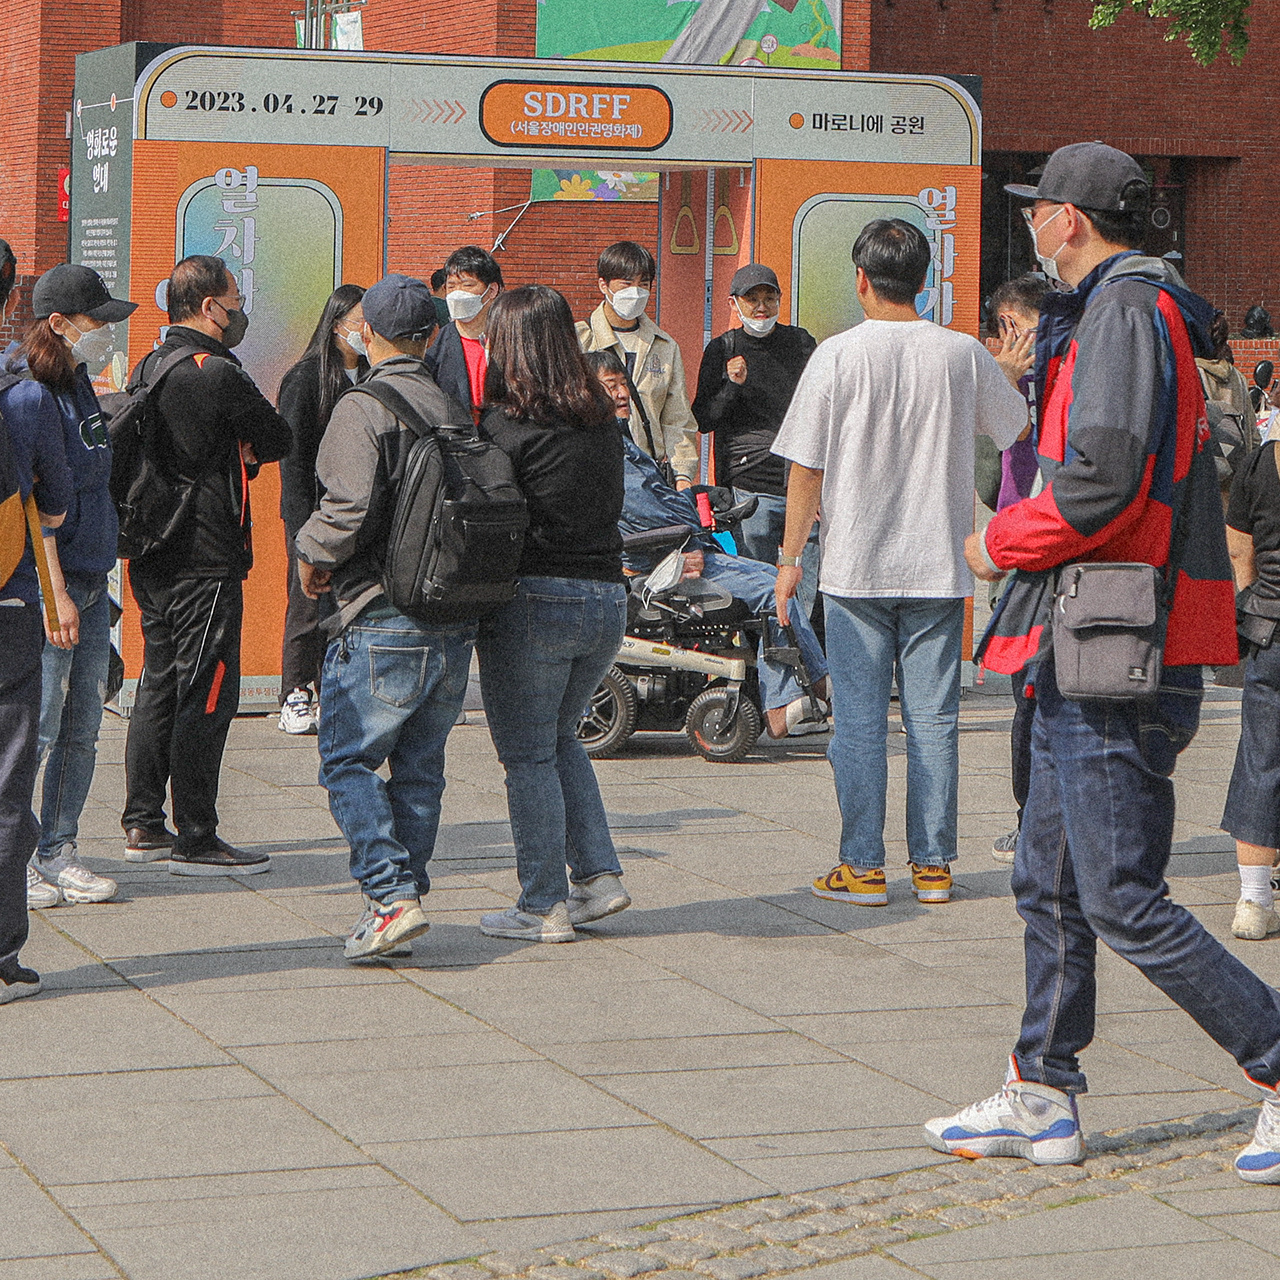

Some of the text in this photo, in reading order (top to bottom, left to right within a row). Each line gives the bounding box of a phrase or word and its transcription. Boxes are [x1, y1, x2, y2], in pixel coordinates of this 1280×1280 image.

[523, 91, 630, 119] SDRFF
[509, 119, 643, 139] (서울장애인인권영화제)
[812, 112, 925, 135] 마로니에 공원
[85, 125, 118, 162] 영화로운
